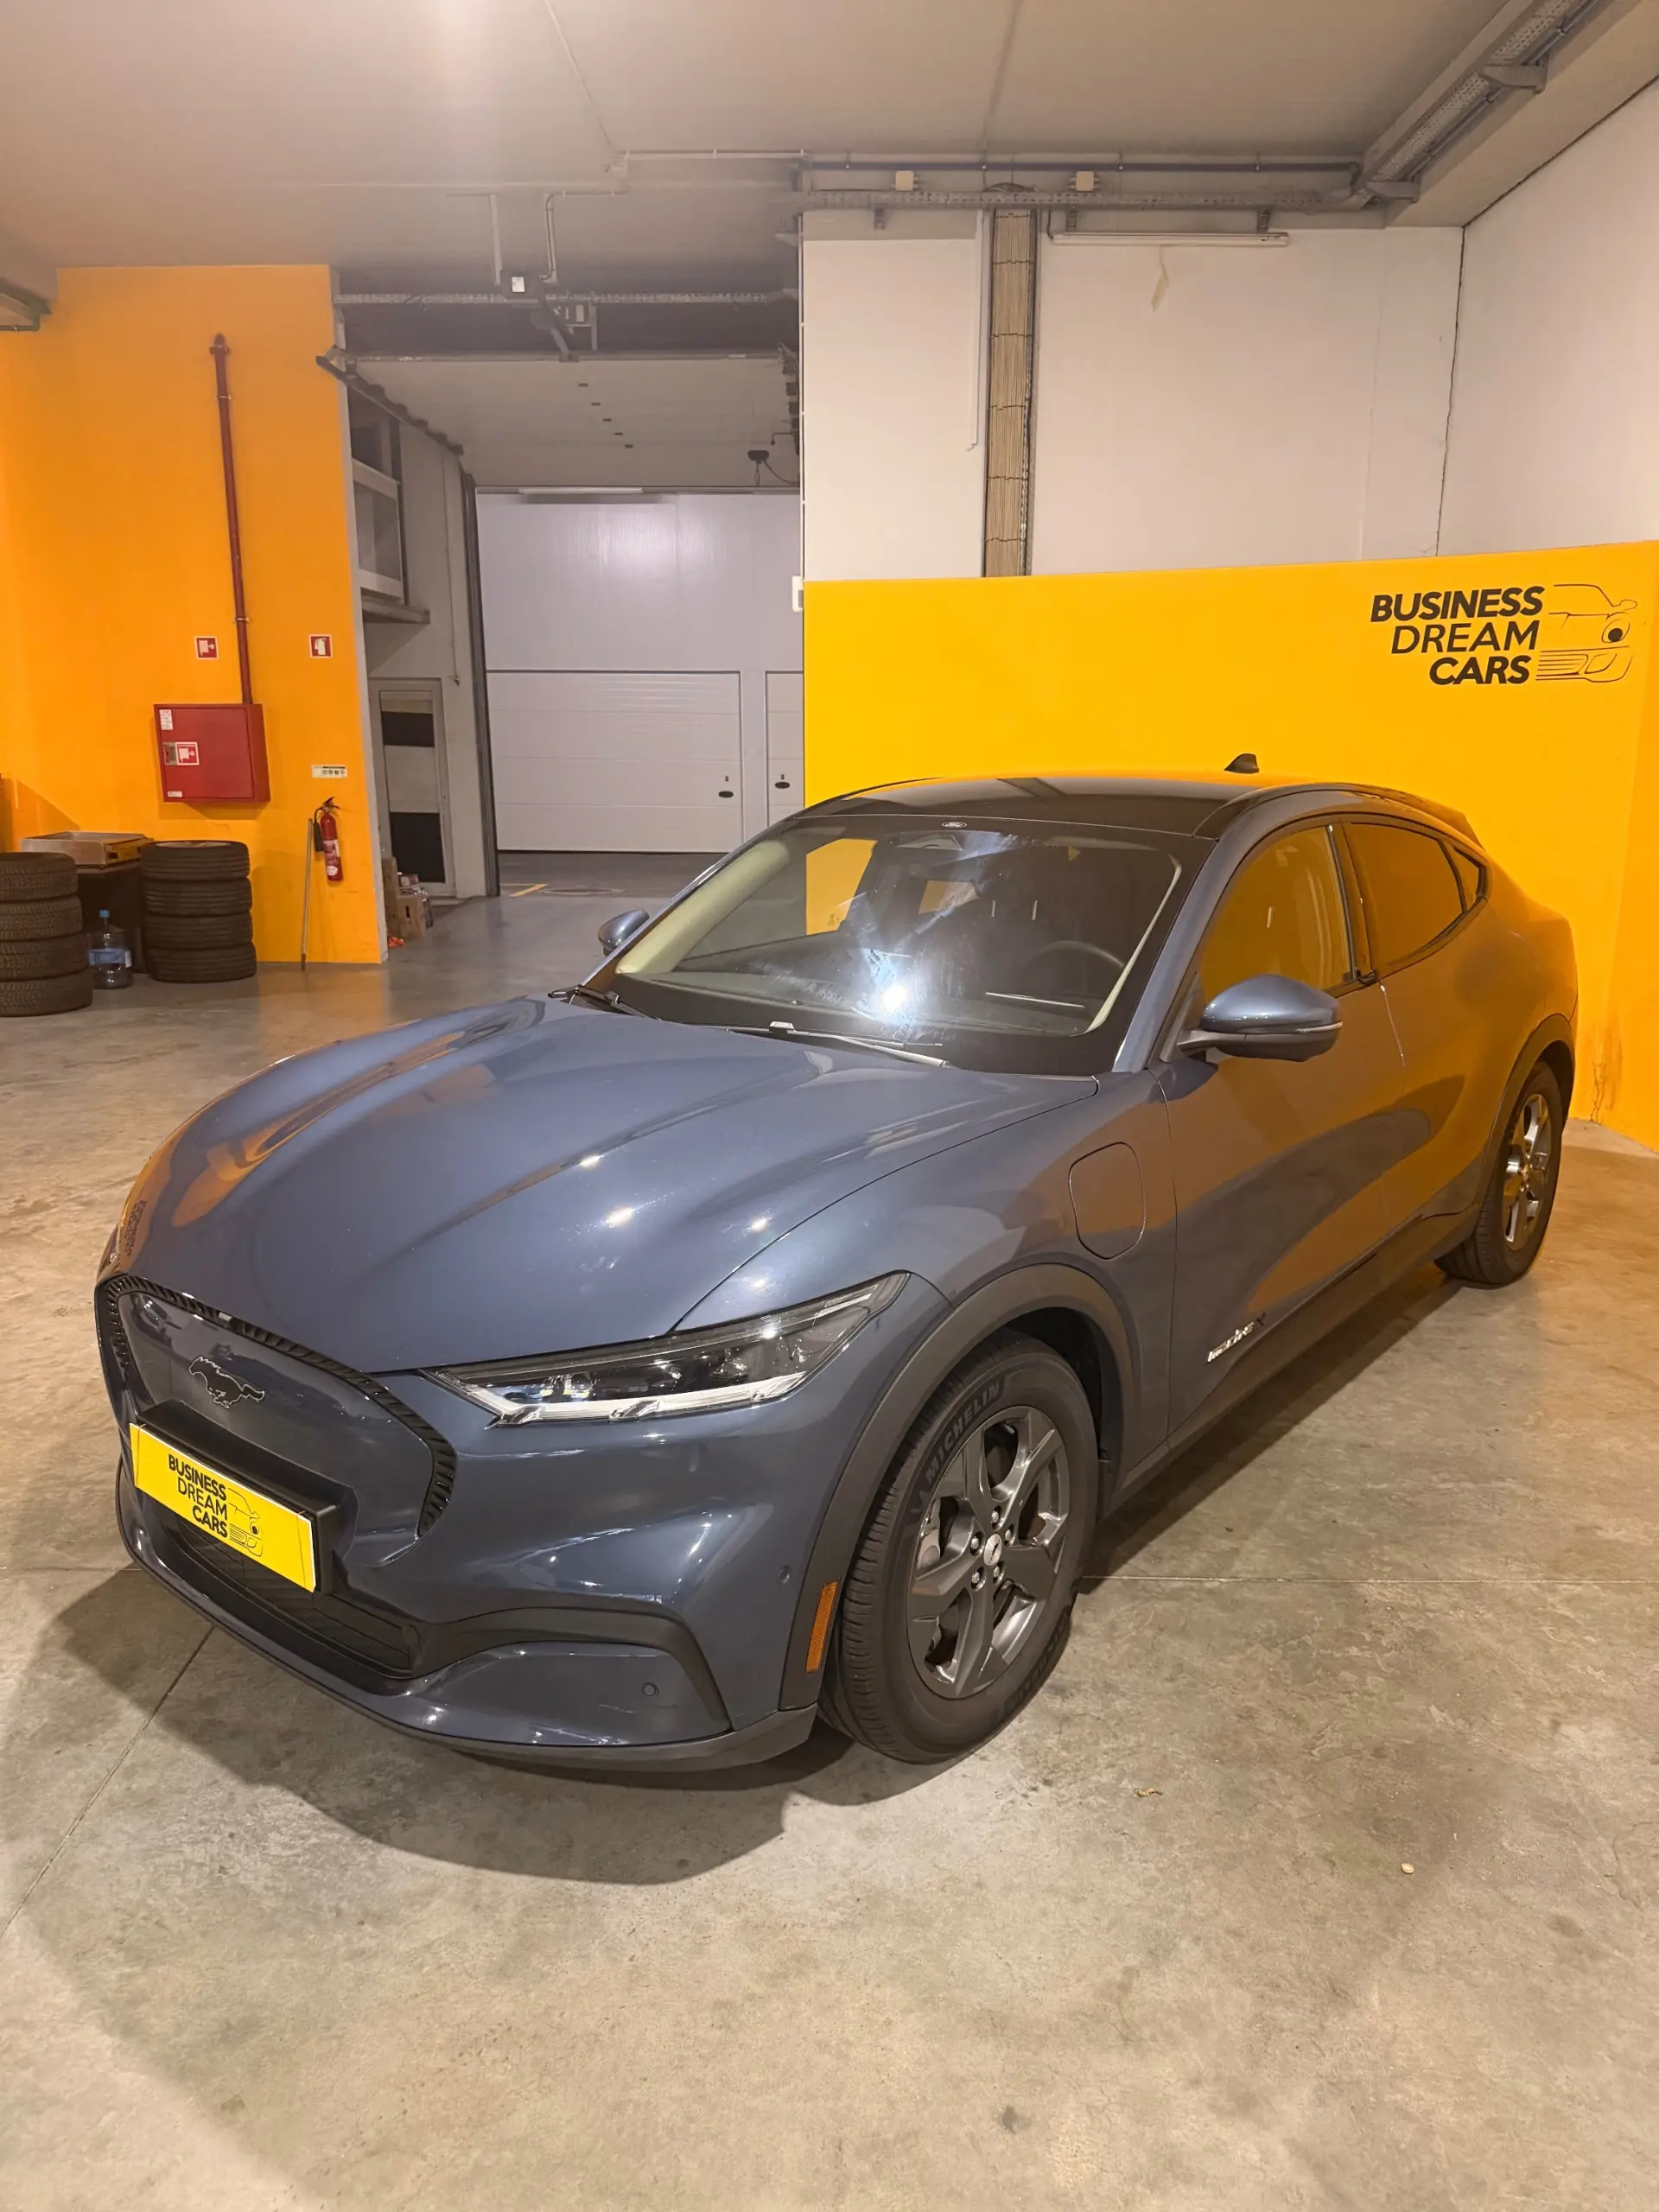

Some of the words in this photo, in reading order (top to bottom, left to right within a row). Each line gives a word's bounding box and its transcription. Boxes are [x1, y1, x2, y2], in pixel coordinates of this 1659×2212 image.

[1370, 586, 1545, 622] BUSINESS
[1391, 620, 1540, 654] DREAM
[1429, 655, 1531, 685] CARS
[925, 1380, 1000, 1484] MICHELIN
[168, 1453, 227, 1501] BUSINESS
[177, 1478, 227, 1521] DREAM
[192, 1505, 228, 1538] CARS
